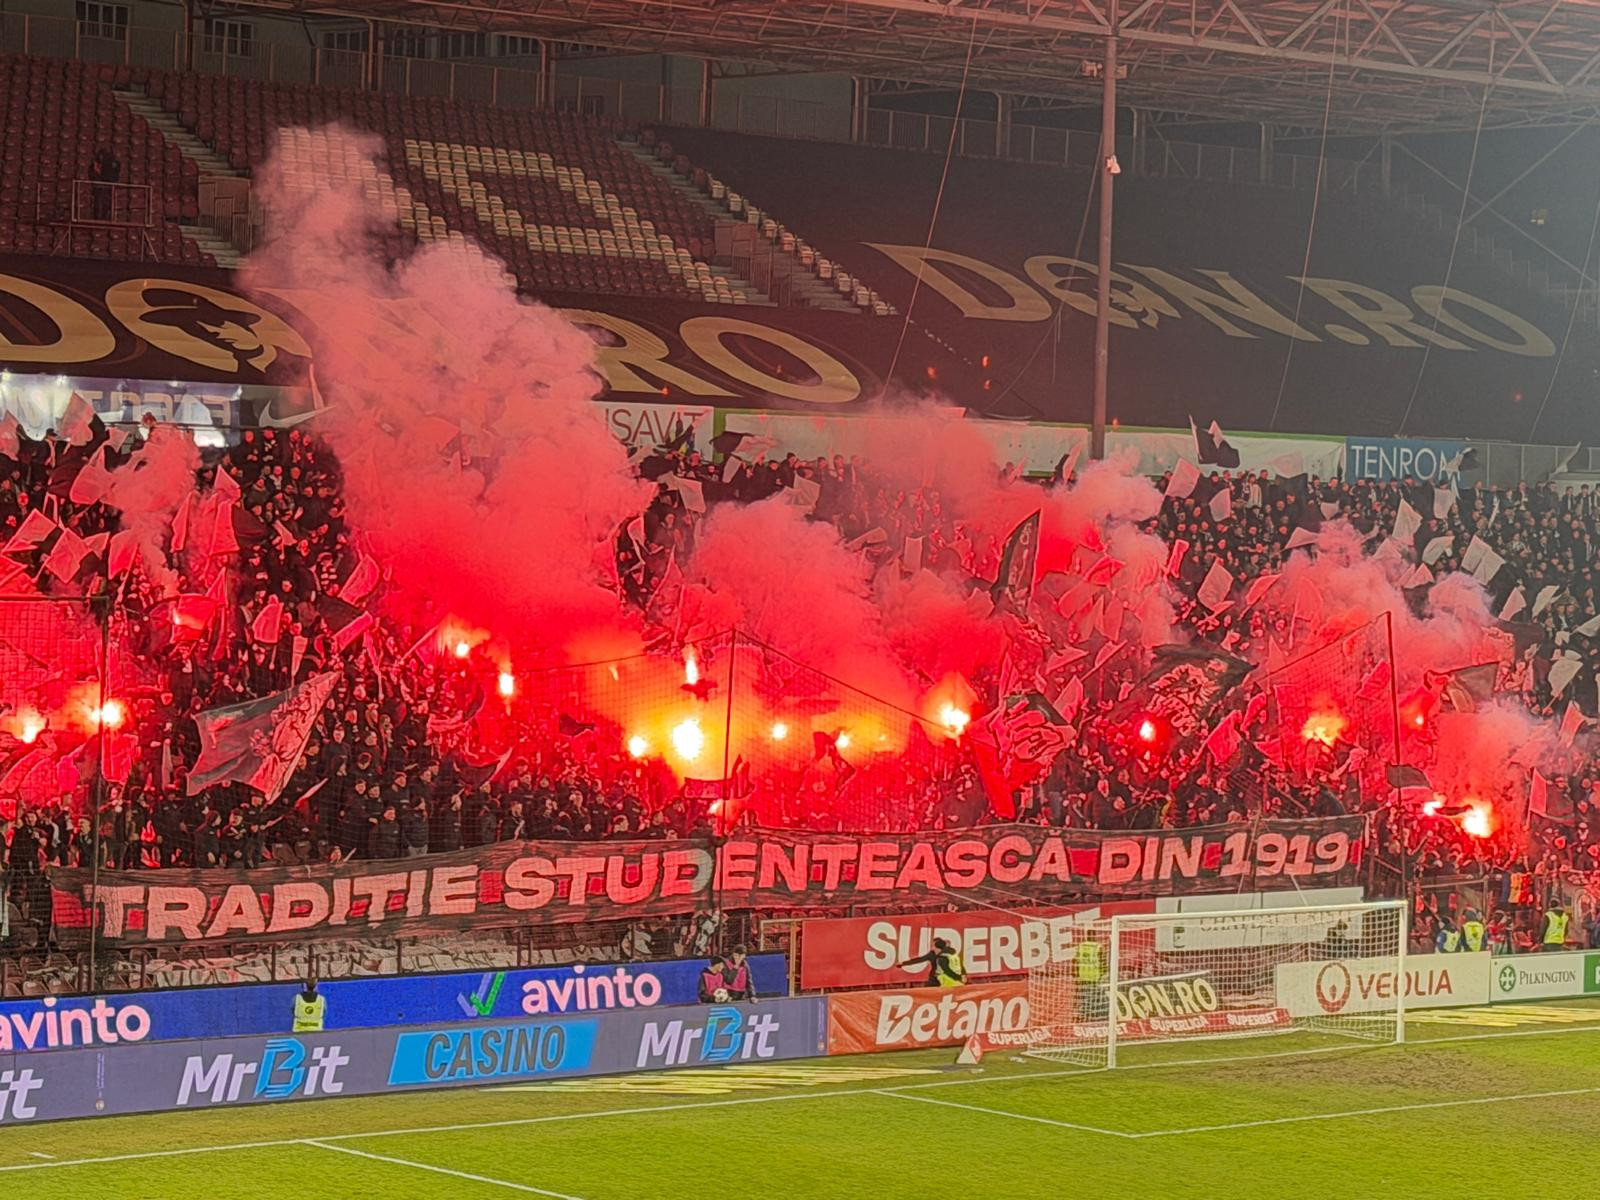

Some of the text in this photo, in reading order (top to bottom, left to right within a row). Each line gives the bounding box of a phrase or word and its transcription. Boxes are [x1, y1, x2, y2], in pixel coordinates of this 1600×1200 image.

[1099, 836, 1203, 885] DIN
[1218, 831, 1350, 878] 1919
[520, 964, 662, 1015] avinto
[1519, 970, 1576, 986] PILKINGTON
[876, 993, 1029, 1045] Betano
[987, 1027, 1052, 1047] SUPERLIGA
[1073, 1022, 1128, 1039] SUPERET
[1150, 1015, 1210, 1032] SUPERLIGA
[176, 1037, 350, 1107] MrBit
[424, 1024, 565, 1081] CASINO
[636, 1007, 780, 1067] MrBit
